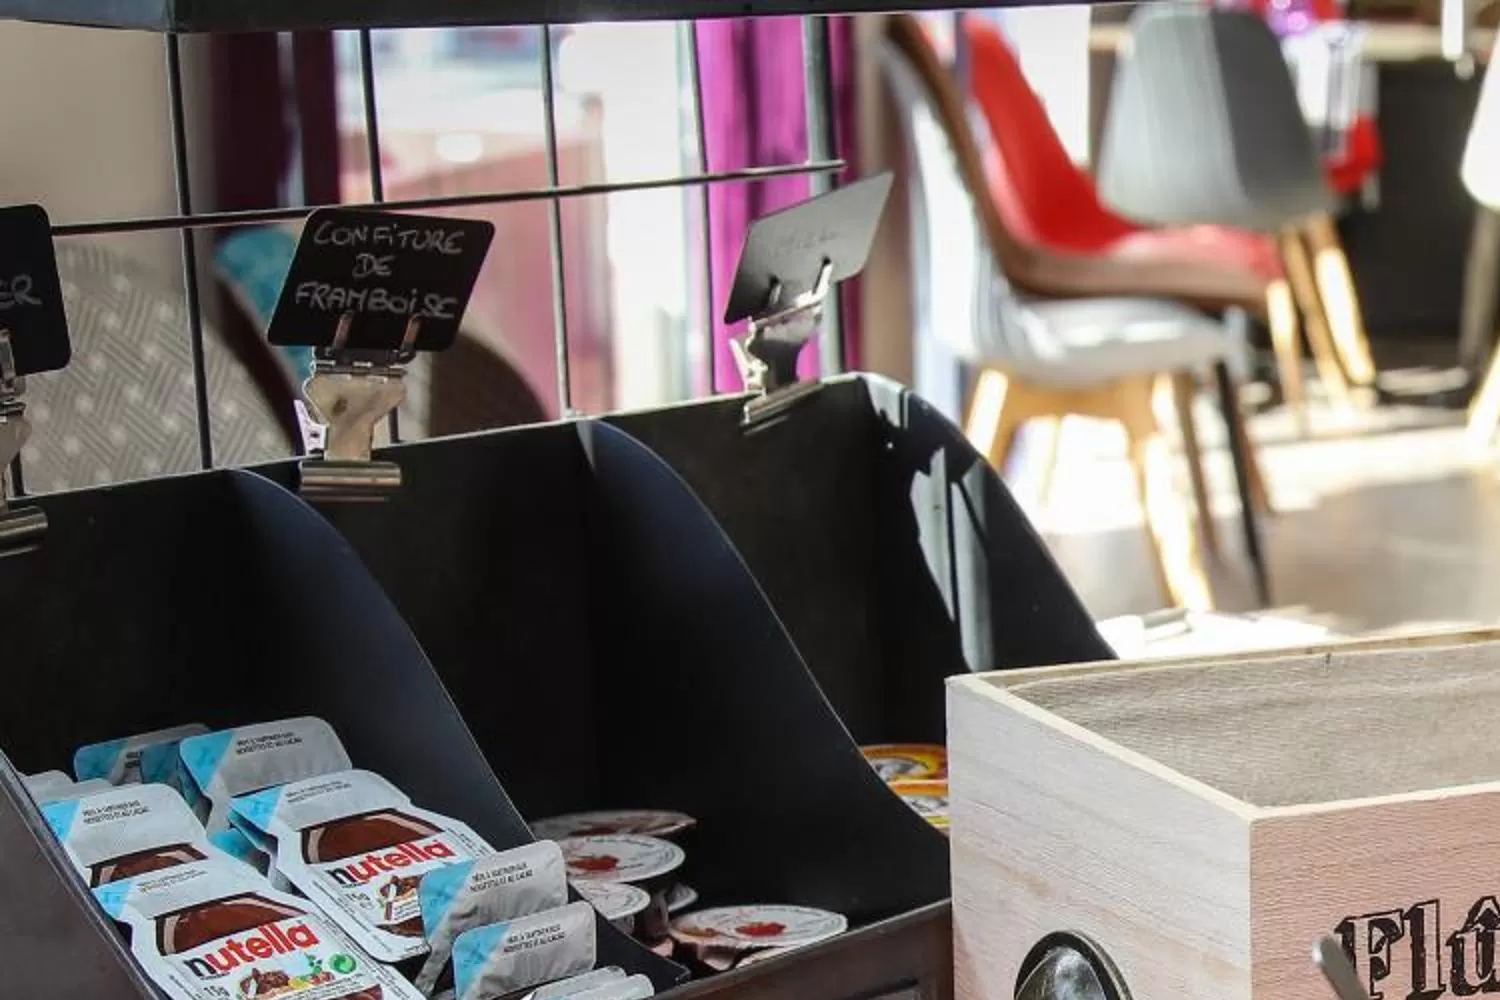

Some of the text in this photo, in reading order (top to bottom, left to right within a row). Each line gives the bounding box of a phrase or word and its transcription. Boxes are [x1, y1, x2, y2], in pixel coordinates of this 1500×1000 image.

[352, 252, 395, 279] DE
[326, 841, 456, 884] nutella
[183, 921, 321, 977] nutella
